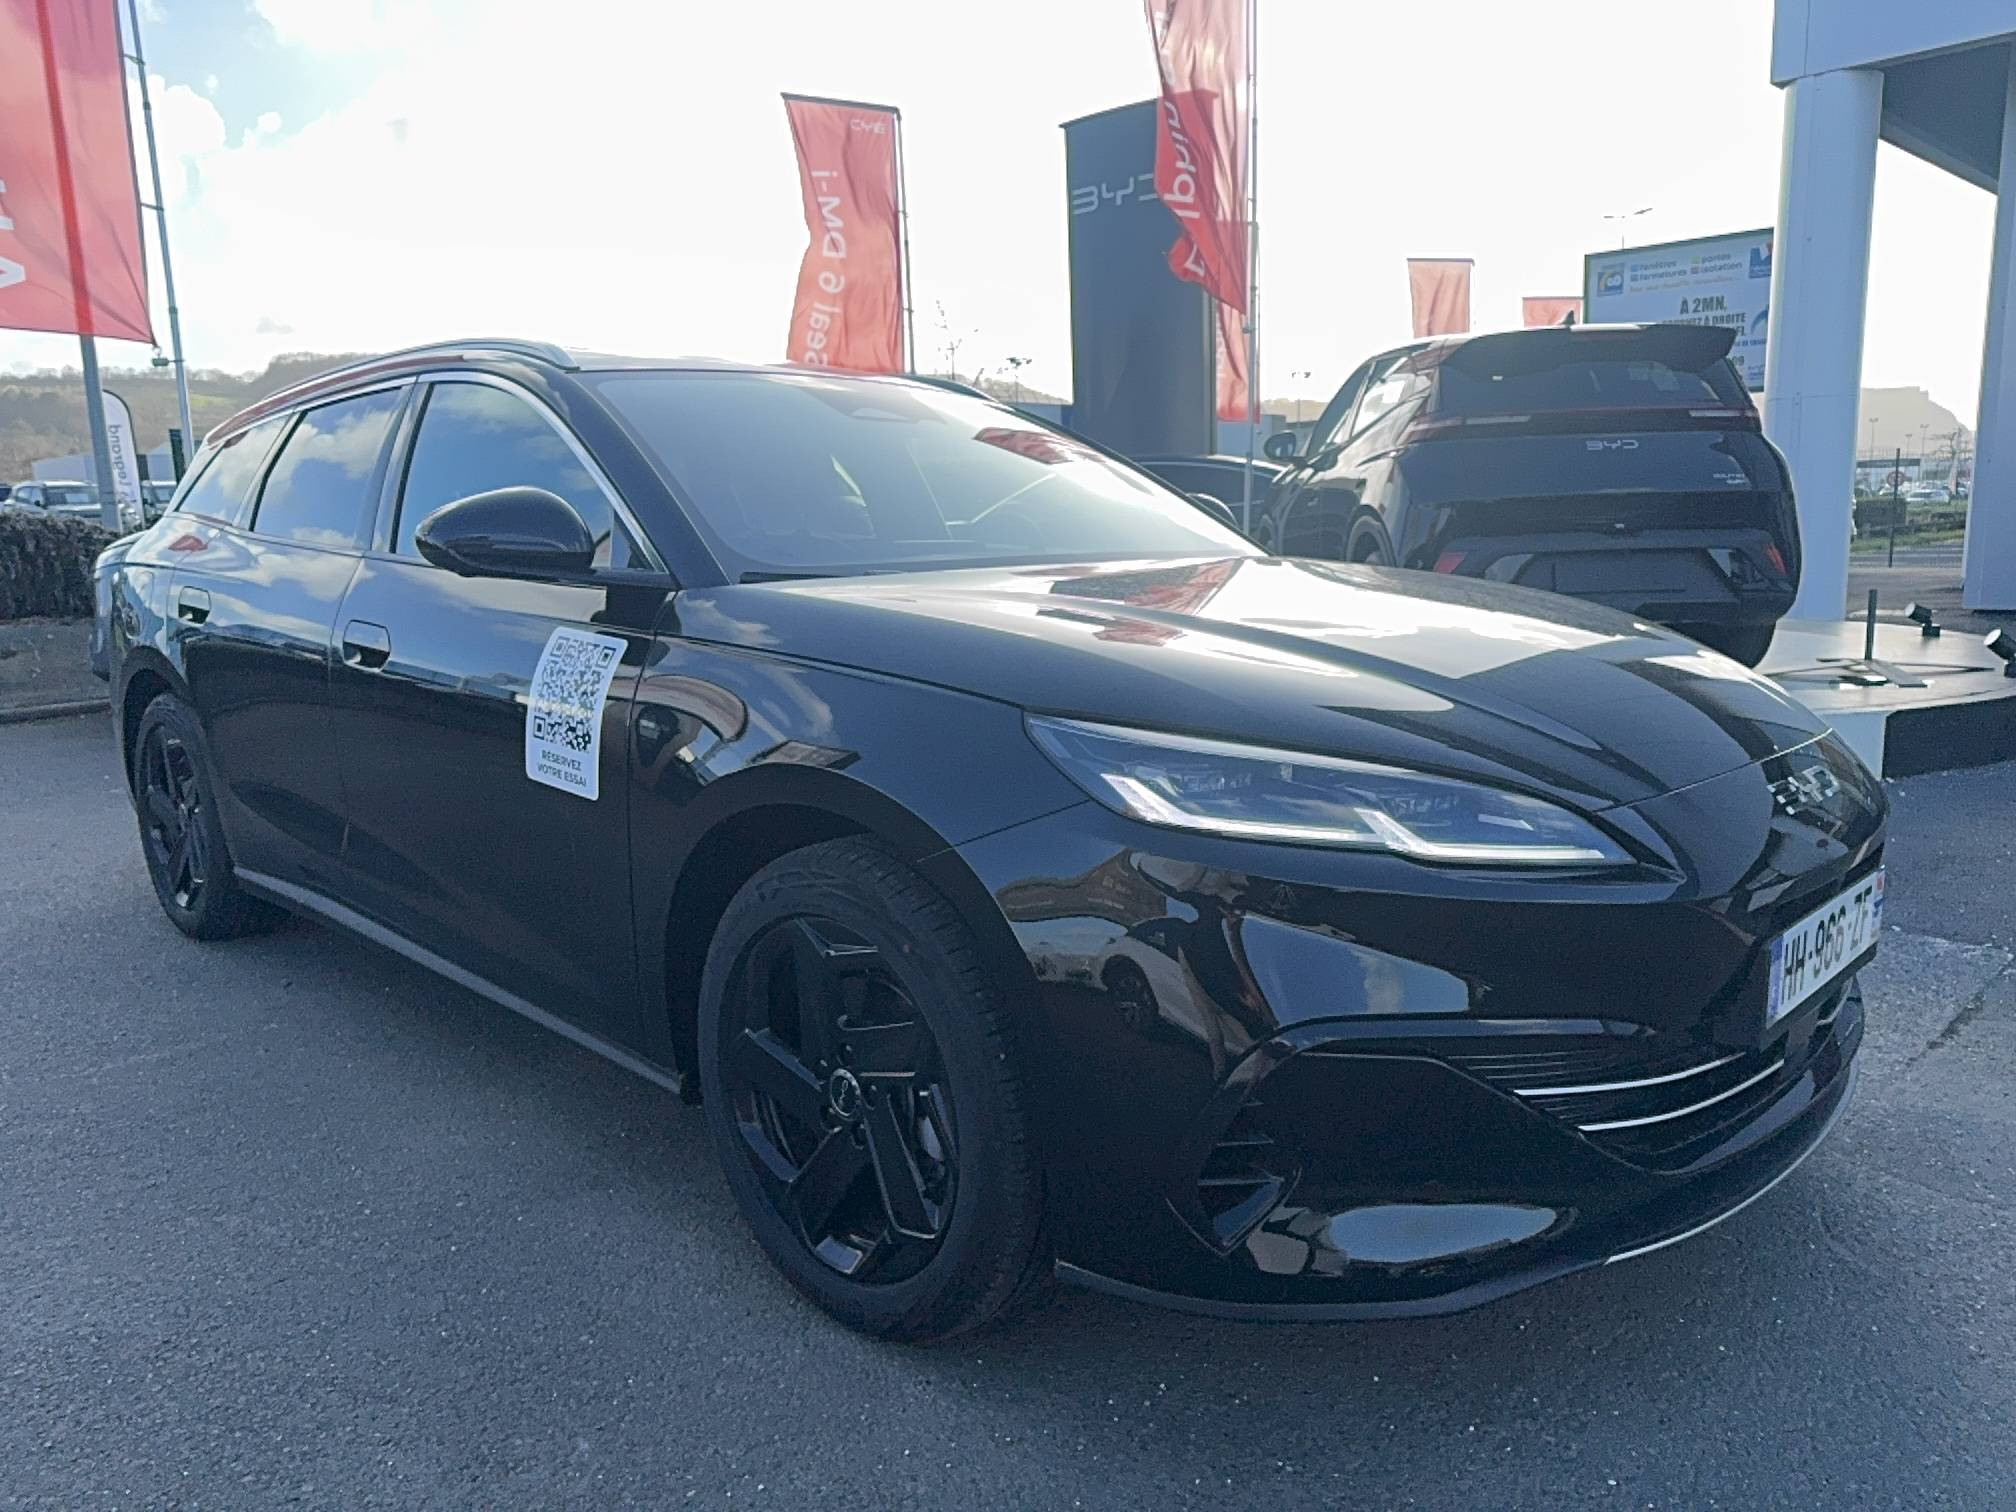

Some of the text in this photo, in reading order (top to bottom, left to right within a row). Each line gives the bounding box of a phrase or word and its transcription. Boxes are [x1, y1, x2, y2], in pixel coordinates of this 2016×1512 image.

[1585, 439, 1640, 451] BYD
[537, 763, 587, 787] VOTRE ESSAI
